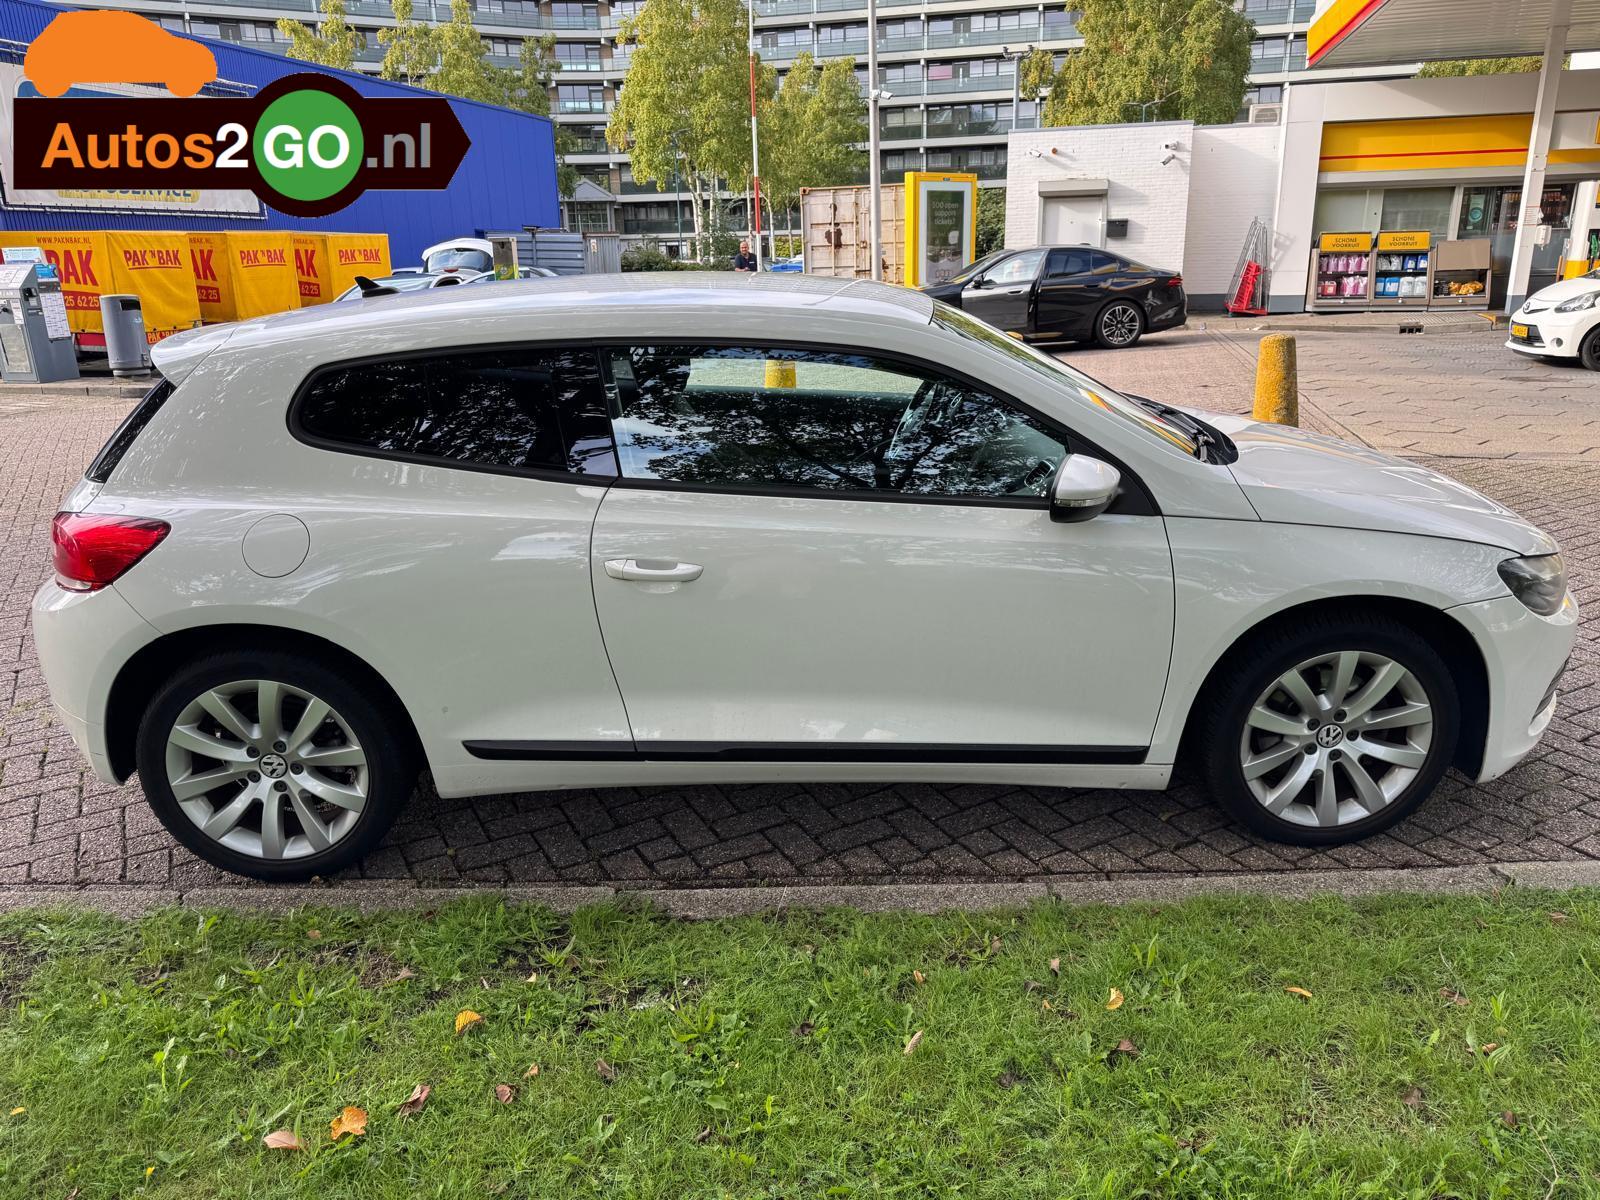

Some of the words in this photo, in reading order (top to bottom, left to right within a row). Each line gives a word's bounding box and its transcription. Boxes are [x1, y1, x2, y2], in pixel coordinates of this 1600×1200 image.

[123, 249, 149, 267] PAK
[157, 249, 182, 266] BAK
[240, 249, 260, 265] PAK
[266, 248, 286, 263] BAK
[338, 249, 357, 263] PAK
[363, 248, 381, 261] BAK
